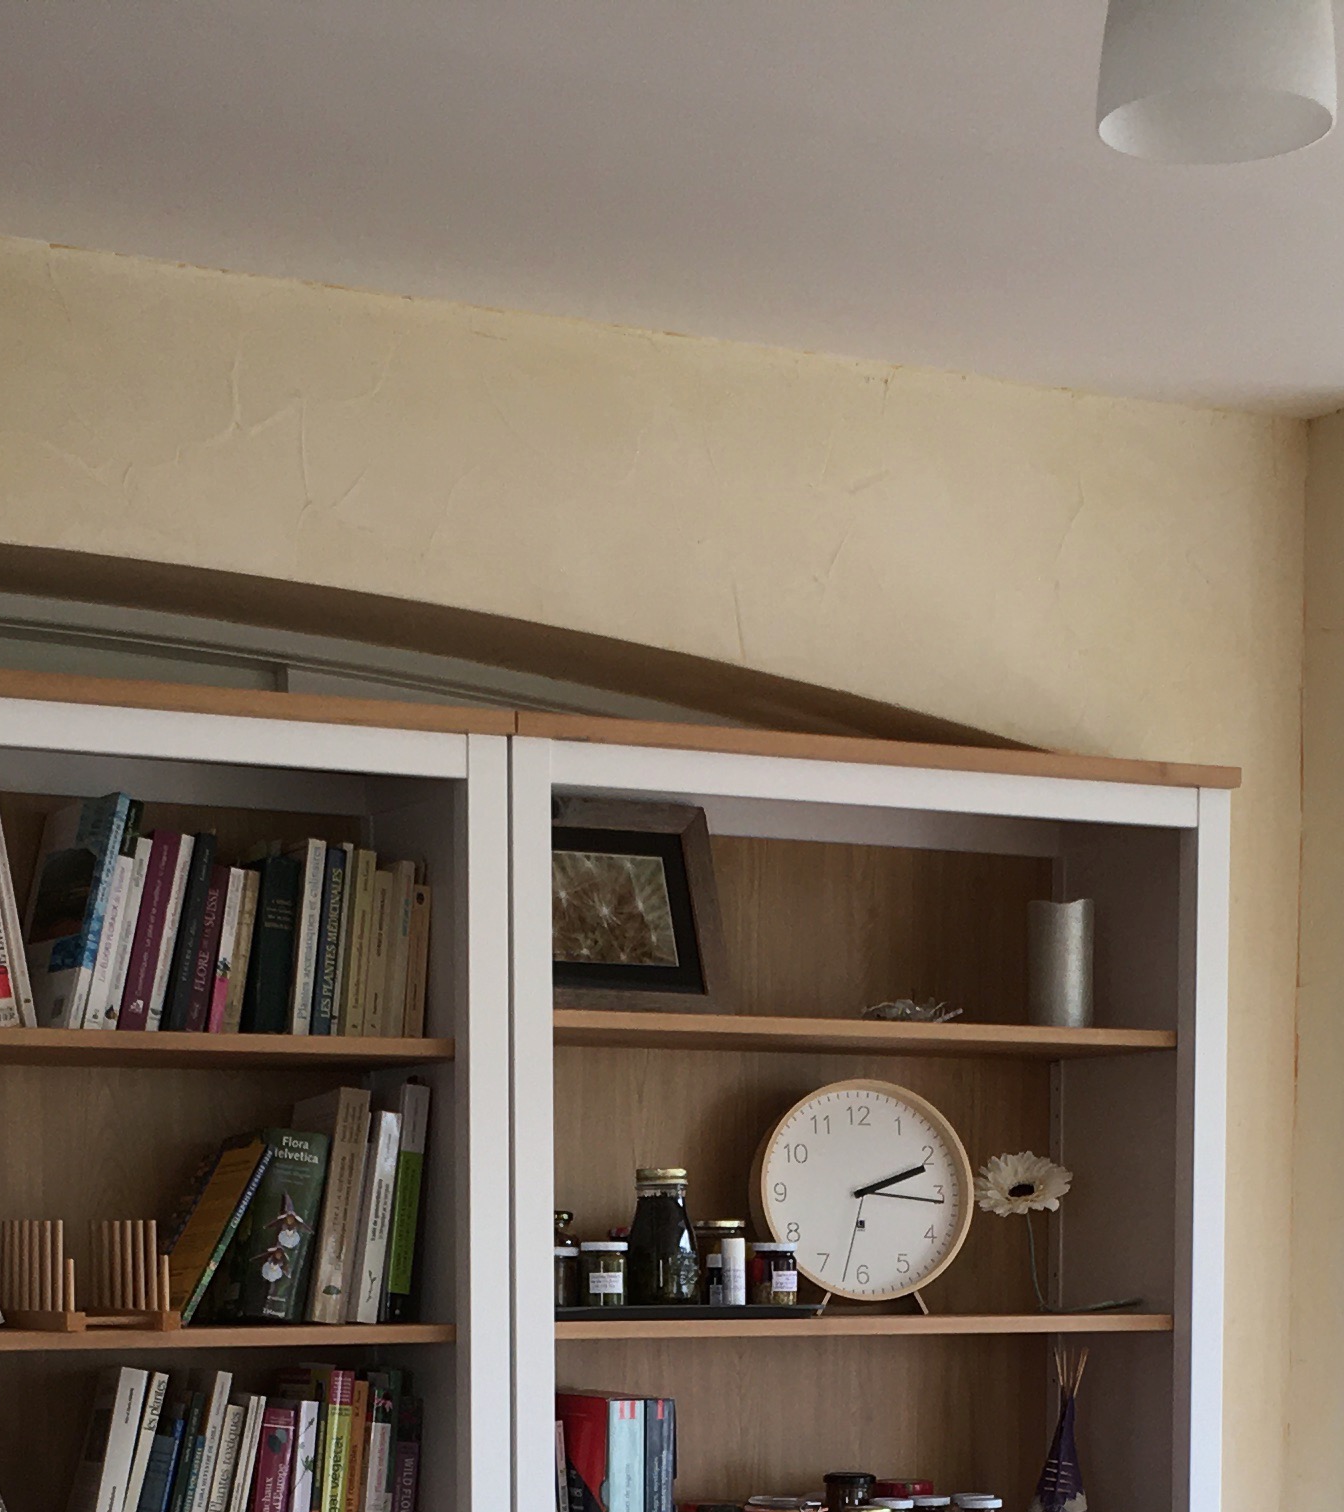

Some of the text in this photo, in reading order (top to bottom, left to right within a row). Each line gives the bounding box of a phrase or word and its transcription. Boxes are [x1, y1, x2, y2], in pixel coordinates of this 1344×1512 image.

[193, 950, 210, 992] FLORE
[202, 887, 219, 928] SUISSE
[321, 943, 336, 997] PLANTES
[296, 981, 310, 1019] Plantes
[319, 997, 332, 1019] LES
[810, 1115, 831, 1135] 11
[846, 1105, 871, 1126] 12
[894, 1116, 901, 1136] 1
[282, 1136, 310, 1150] Flora
[783, 1143, 809, 1164] 10
[921, 1145, 935, 1166] 2
[773, 1182, 787, 1203] 9
[933, 1184, 945, 1205] 3
[786, 1222, 801, 1242] 8
[923, 1225, 938, 1245] 4
[816, 1252, 830, 1273] 7
[896, 1253, 910, 1274] 5
[856, 1265, 870, 1285] 6
[142, 1378, 168, 1432] les plantes
[219, 1409, 244, 1466] toxiques
[401, 1456, 414, 1486] WILD
[271, 1462, 289, 1510] d'Europe
